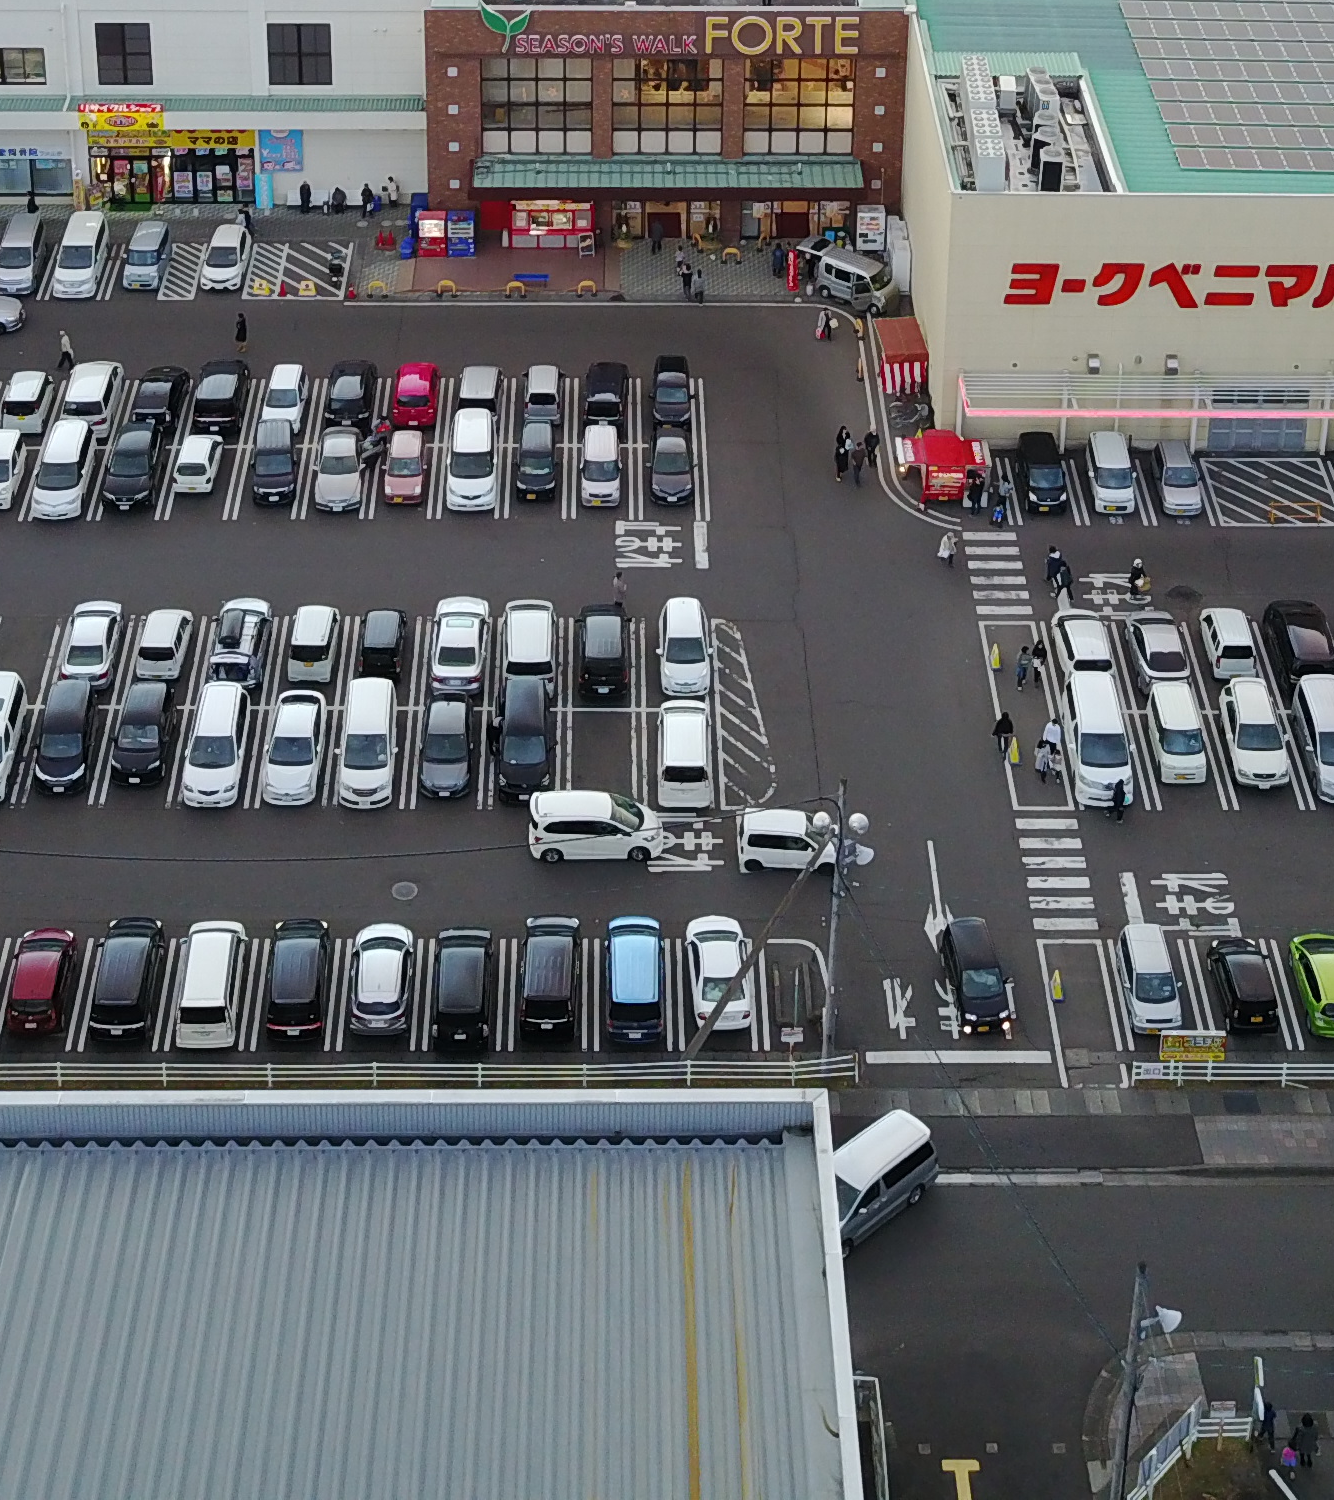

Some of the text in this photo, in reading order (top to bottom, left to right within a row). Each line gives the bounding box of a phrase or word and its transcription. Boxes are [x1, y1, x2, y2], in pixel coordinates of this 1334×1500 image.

[515, 16, 860, 54] SEASON'S WALK FORTE
[188, 136, 238, 145] ママの店
[615, 521, 683, 569] 止まれ
